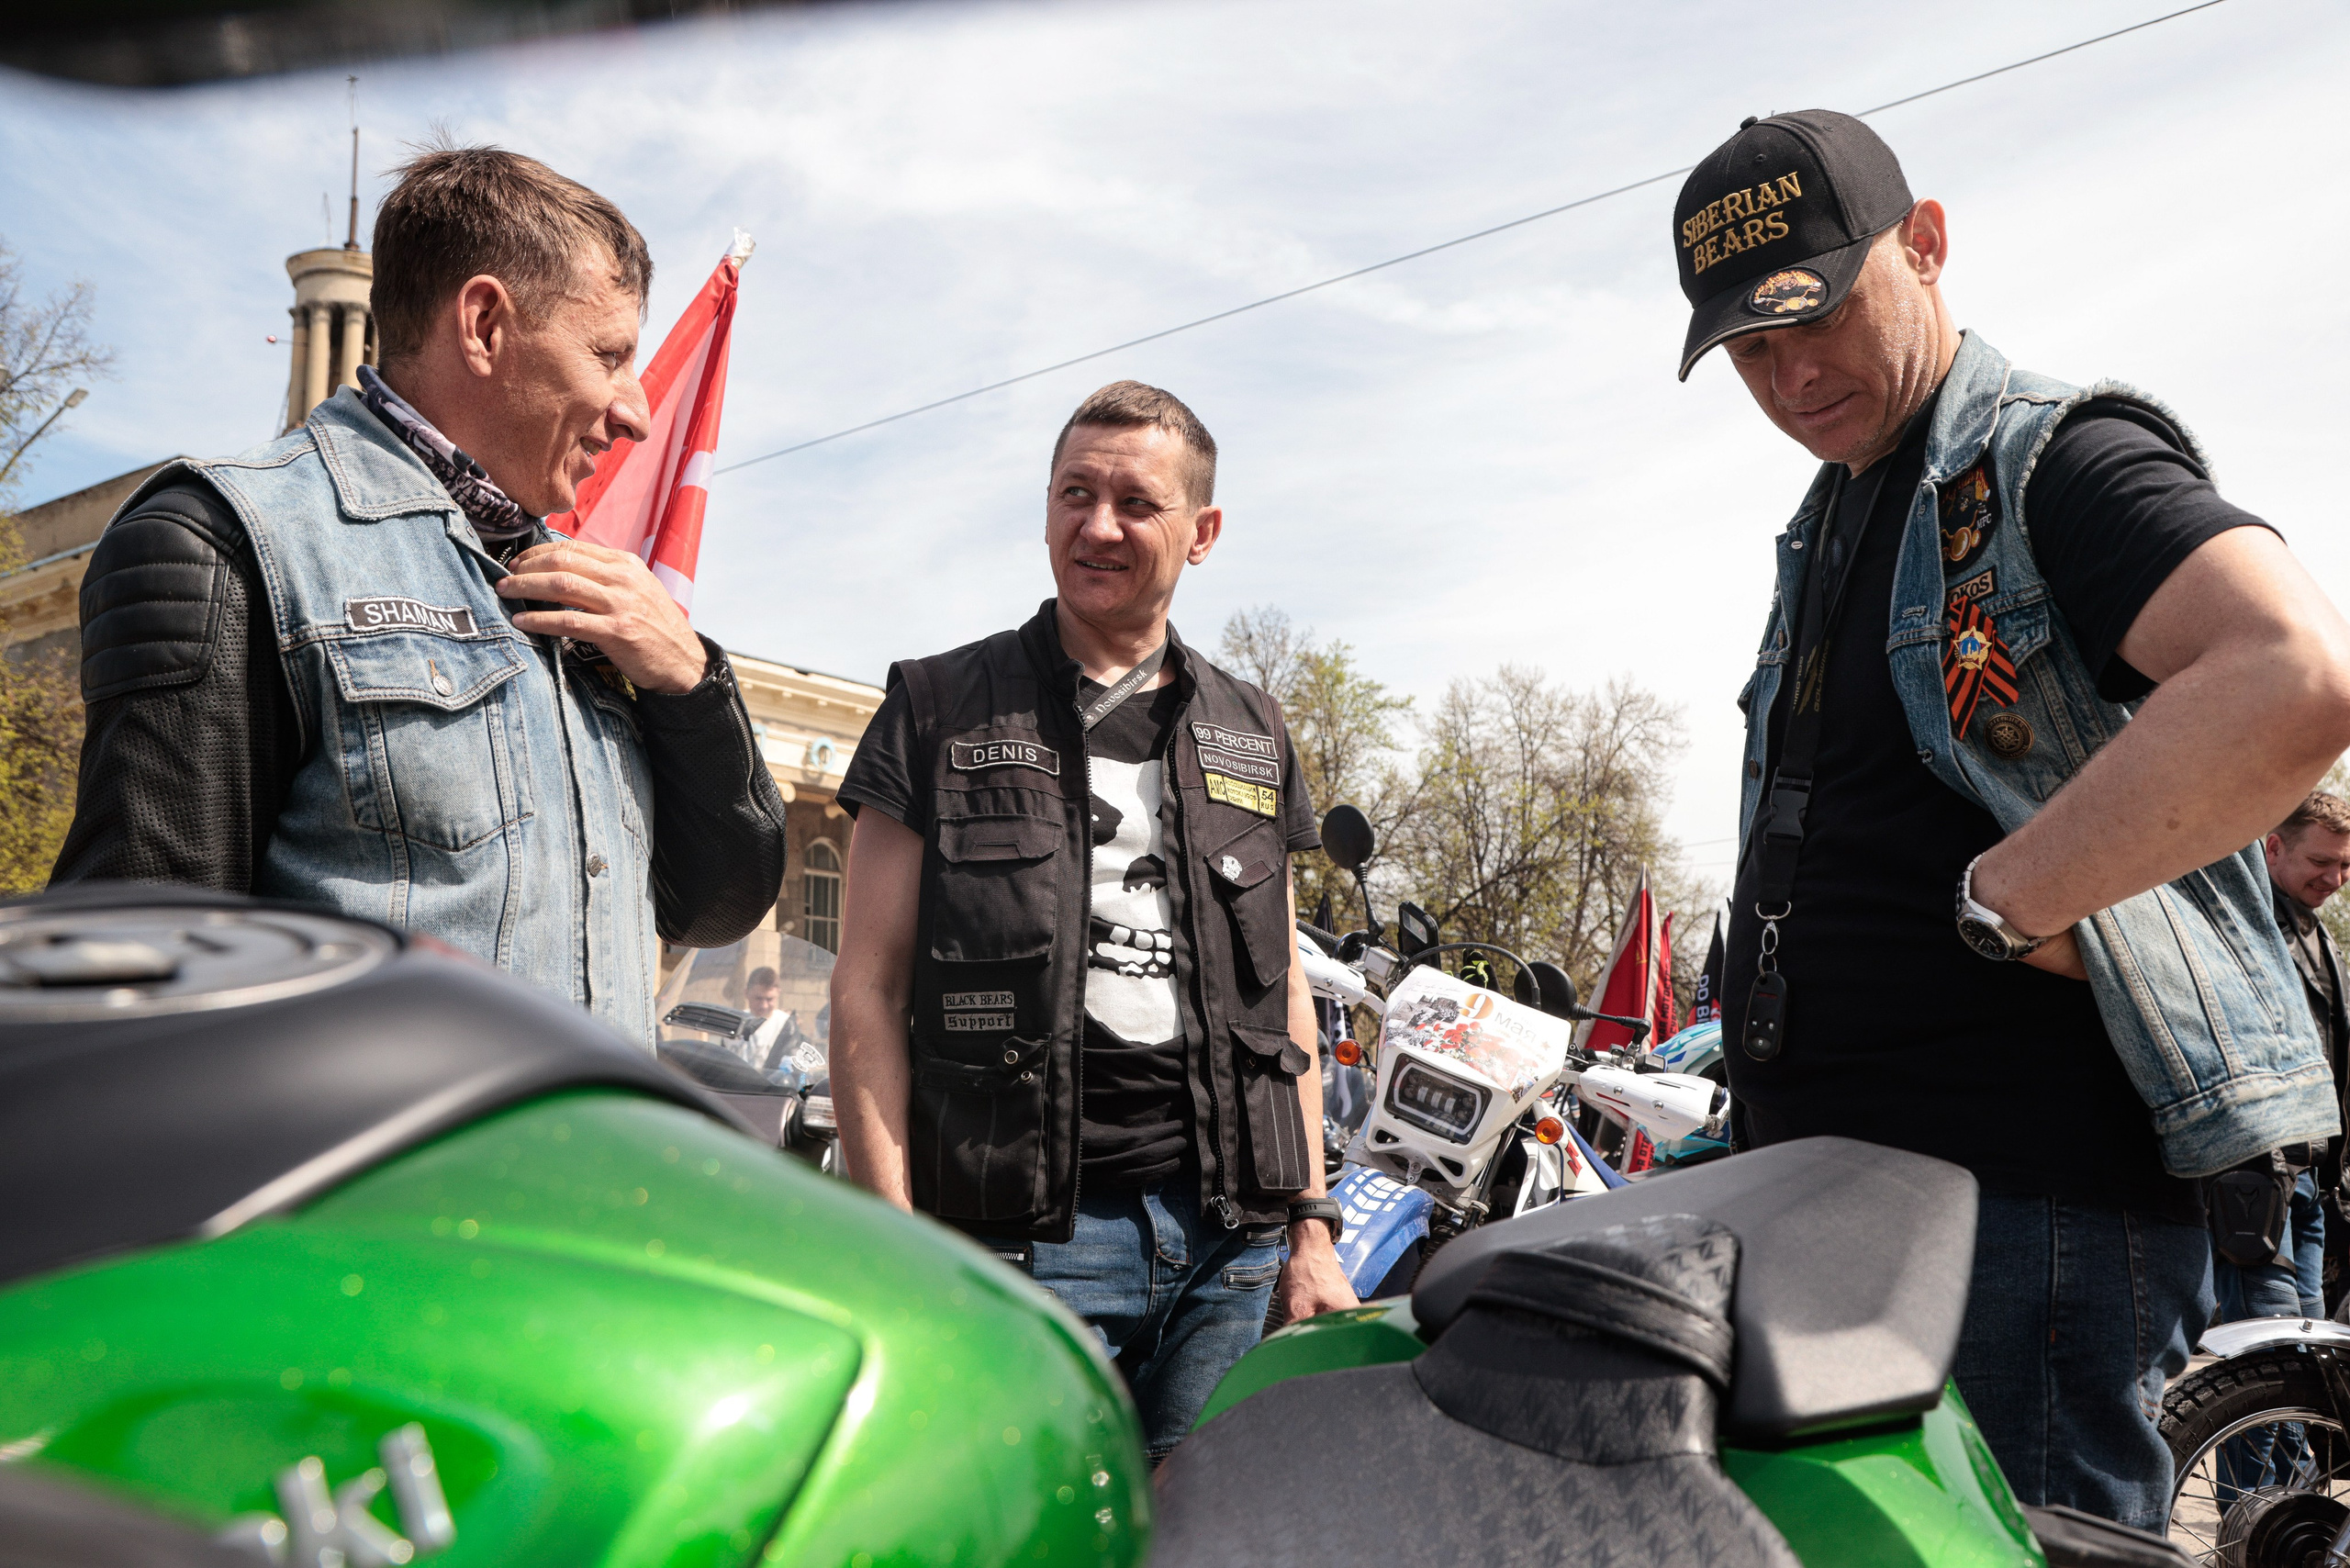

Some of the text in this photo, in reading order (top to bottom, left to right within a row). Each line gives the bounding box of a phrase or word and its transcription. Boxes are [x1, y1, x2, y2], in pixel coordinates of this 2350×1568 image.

[1683, 171, 1802, 248] SIBERIAN
[1694, 210, 1789, 274] BEARS
[364, 601, 458, 632] SHAMAN
[1095, 669, 1147, 713] Novosibirsk
[1195, 727, 1272, 754] 99 PERCENT
[973, 745, 1037, 763] DENIS
[1203, 753, 1273, 778] NOVOSIBIRSK
[1260, 801, 1274, 812] RUS
[1261, 790, 1274, 802] 54
[945, 993, 1013, 1006] BLACK BEARS
[1459, 992, 1494, 1020] 9
[947, 1012, 1012, 1030] Support
